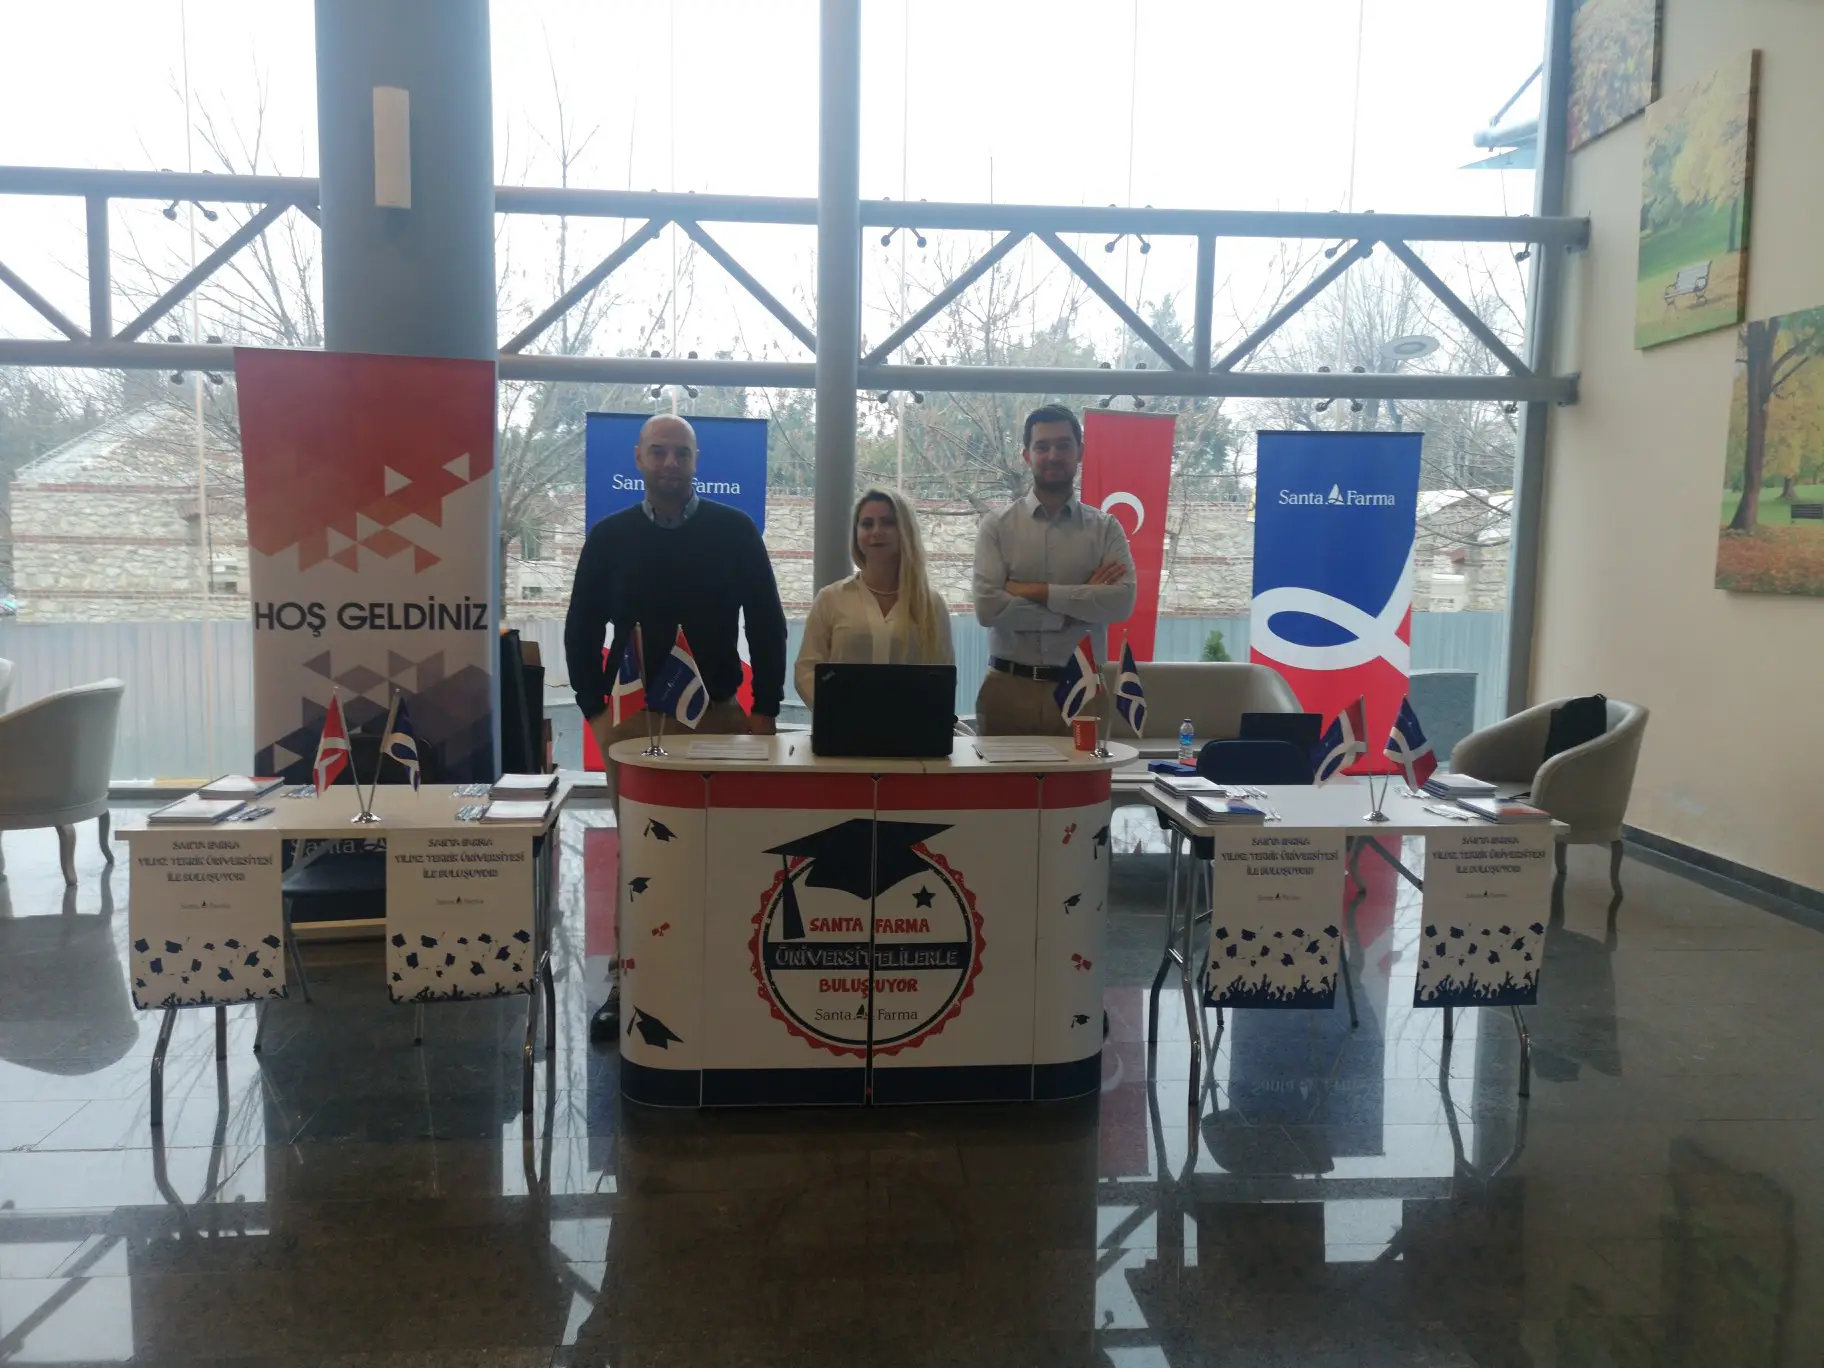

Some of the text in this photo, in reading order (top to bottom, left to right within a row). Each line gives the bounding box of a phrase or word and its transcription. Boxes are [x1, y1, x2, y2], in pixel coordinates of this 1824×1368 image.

[612, 473, 645, 490] San
[1279, 489, 1396, 506] Santa Farma
[254, 595, 488, 638] HOŞ GELDİNİZ
[809, 917, 930, 934] SANTA FARMA
[818, 978, 919, 999] BULUŞUYOR
[814, 1008, 918, 1021] Santa Farma
